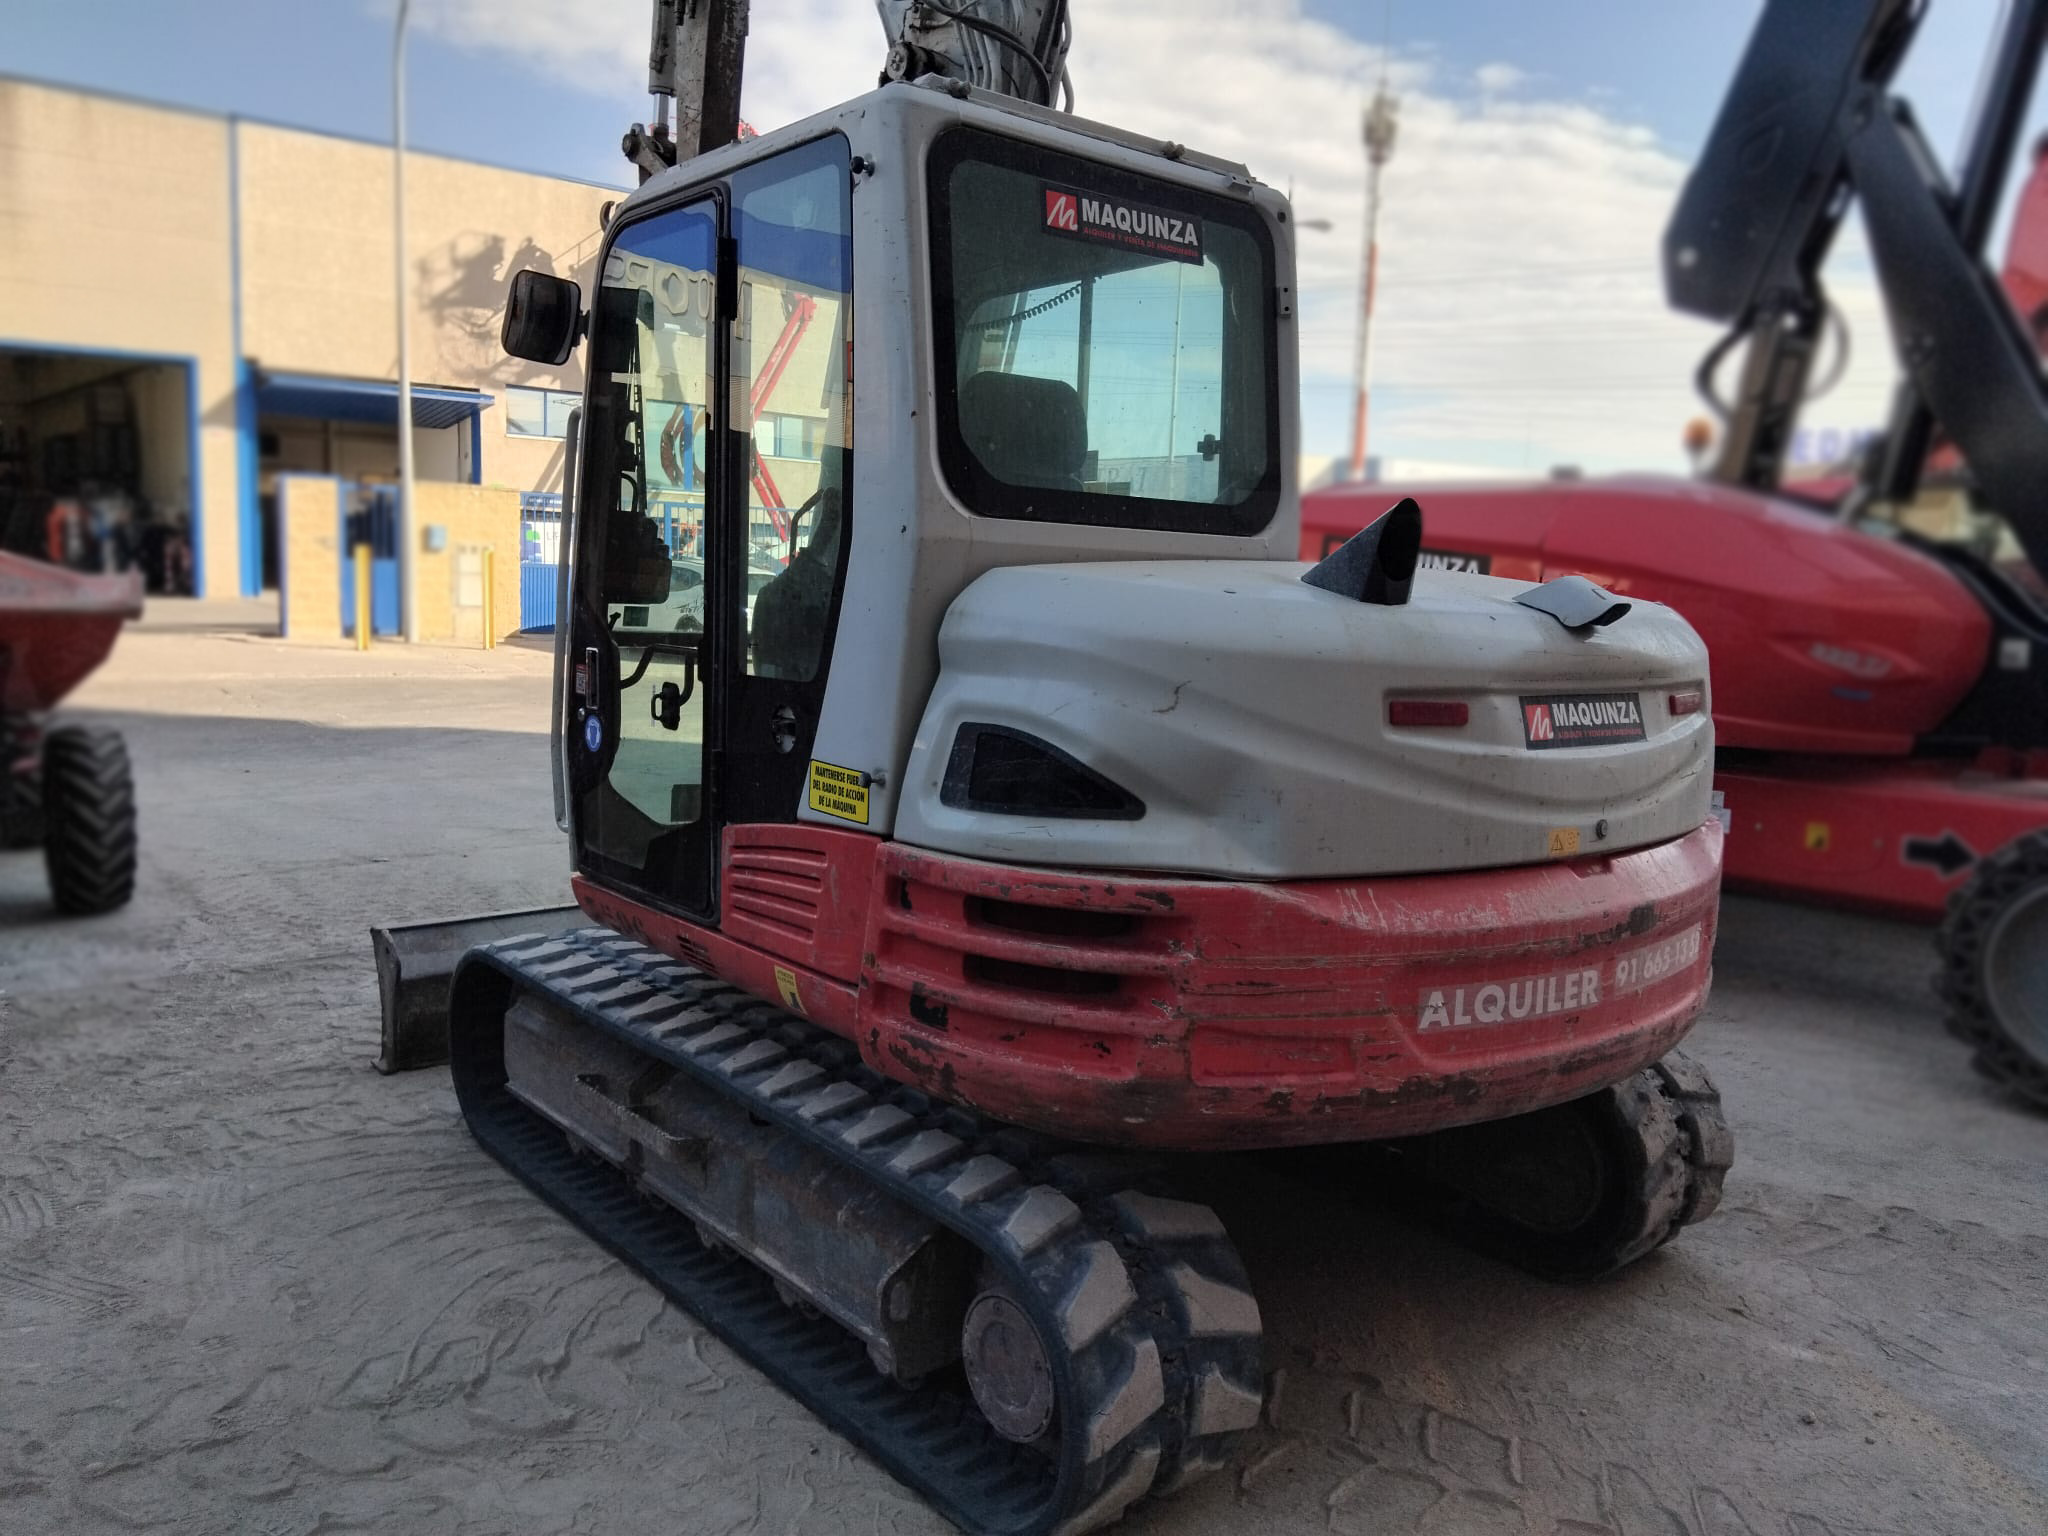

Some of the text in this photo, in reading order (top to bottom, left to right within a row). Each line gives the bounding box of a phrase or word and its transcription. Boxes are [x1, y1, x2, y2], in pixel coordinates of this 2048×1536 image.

[1081, 198, 1198, 246] MAQUINZA
[1551, 701, 1640, 727] MAQUINZA
[814, 766, 846, 783] MANTENERSE
[812, 779, 821, 791] DEL
[822, 783, 837, 795] RADIO
[838, 786, 845, 797] DE
[818, 795, 825, 806] DE
[825, 797, 832, 808] LA
[1418, 969, 1600, 1030] ALQUILER
[1616, 958, 1637, 988] 91
